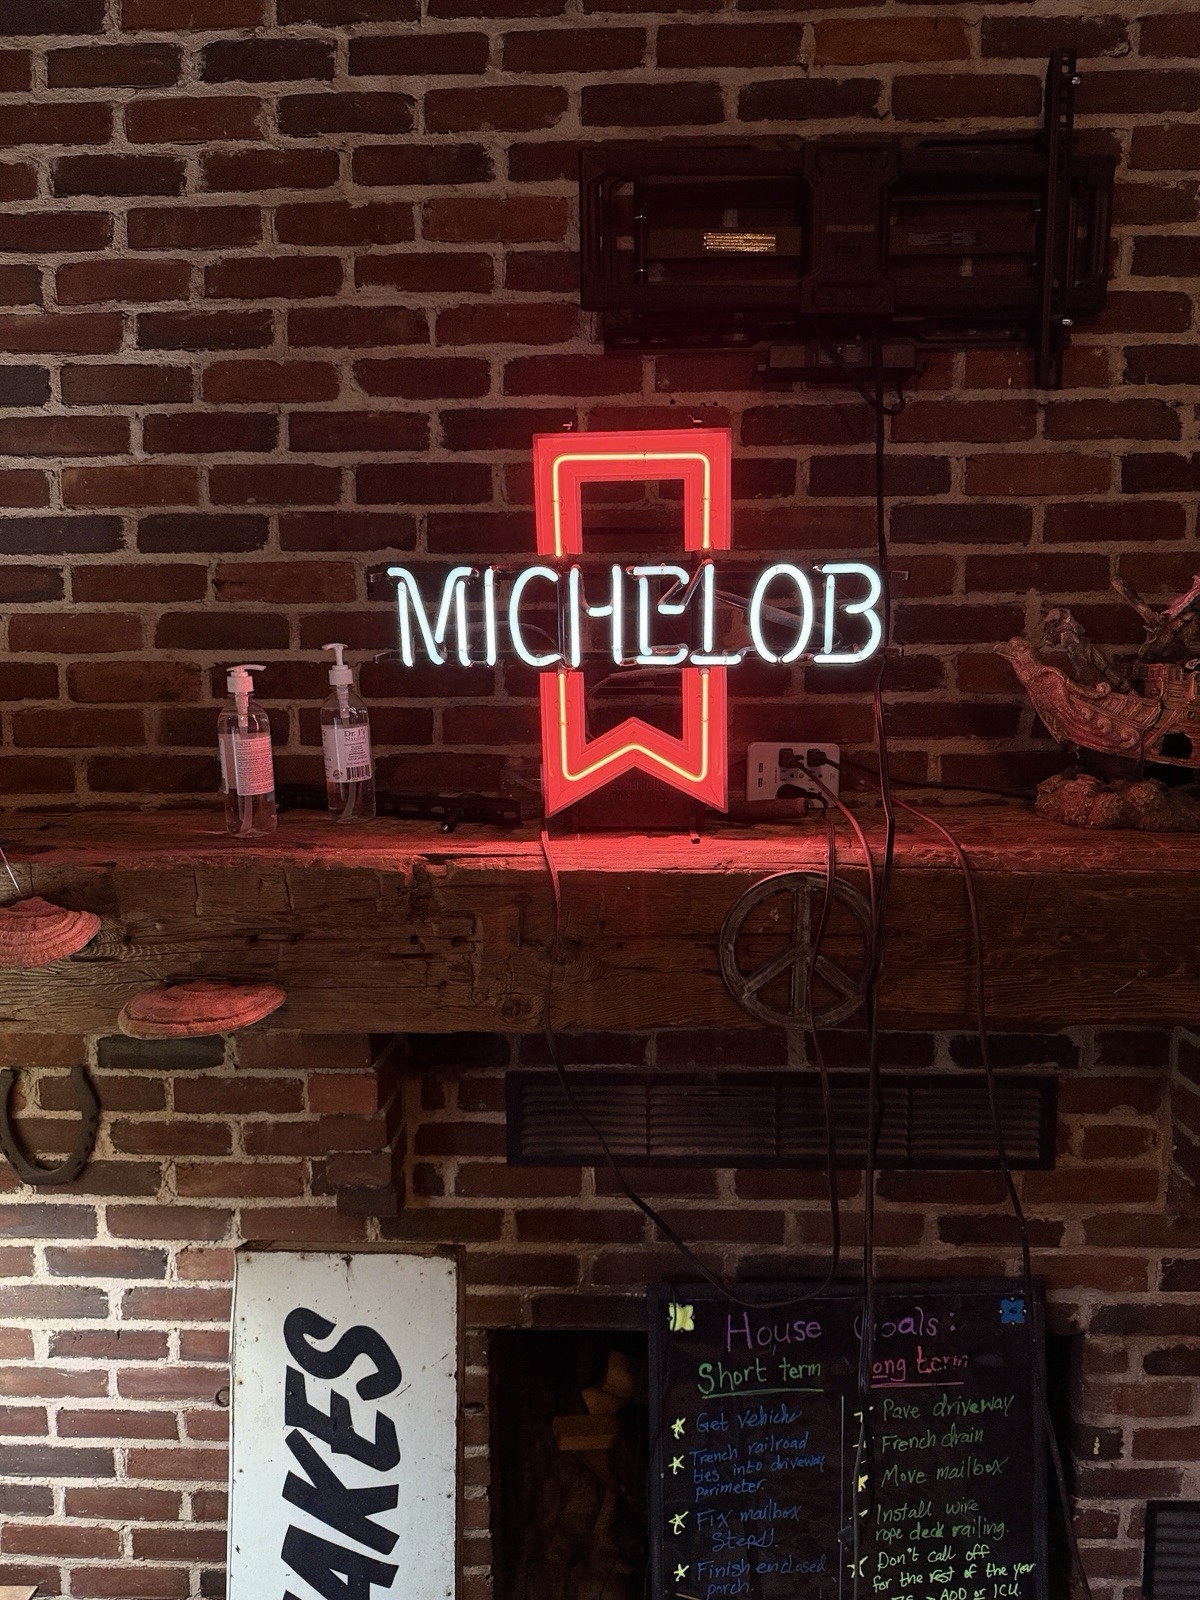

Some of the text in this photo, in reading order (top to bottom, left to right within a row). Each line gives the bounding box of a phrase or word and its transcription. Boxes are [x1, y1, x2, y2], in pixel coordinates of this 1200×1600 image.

[825, 223, 876, 233] PERLEGEAR
[387, 562, 883, 668] MICHELOB
[726, 1311, 823, 1353] House
[697, 1356, 822, 1395] Short term
[871, 1357, 907, 1382] ong
[696, 1412, 730, 1433] Get
[882, 1392, 1015, 1422] Pave driveway
[280, 1307, 402, 1600] AKES
[689, 1430, 809, 1467] Trench railroad
[881, 1422, 984, 1454] French drain
[692, 1453, 826, 1484] ties into driveway
[880, 1455, 1010, 1488] Move mailbox
[695, 1497, 802, 1532] Fix mailbox
[876, 1496, 980, 1525] Install wire
[875, 1527, 904, 1545] rope
[909, 1521, 945, 1541] deck
[696, 1553, 827, 1581] Finish enclosed
[876, 1543, 991, 1572] Don't call off
[872, 1575, 893, 1593] for
[899, 1571, 924, 1588] the
[928, 1565, 956, 1584] rest
[985, 1562, 1009, 1579] the
[1012, 1562, 1037, 1581] year
